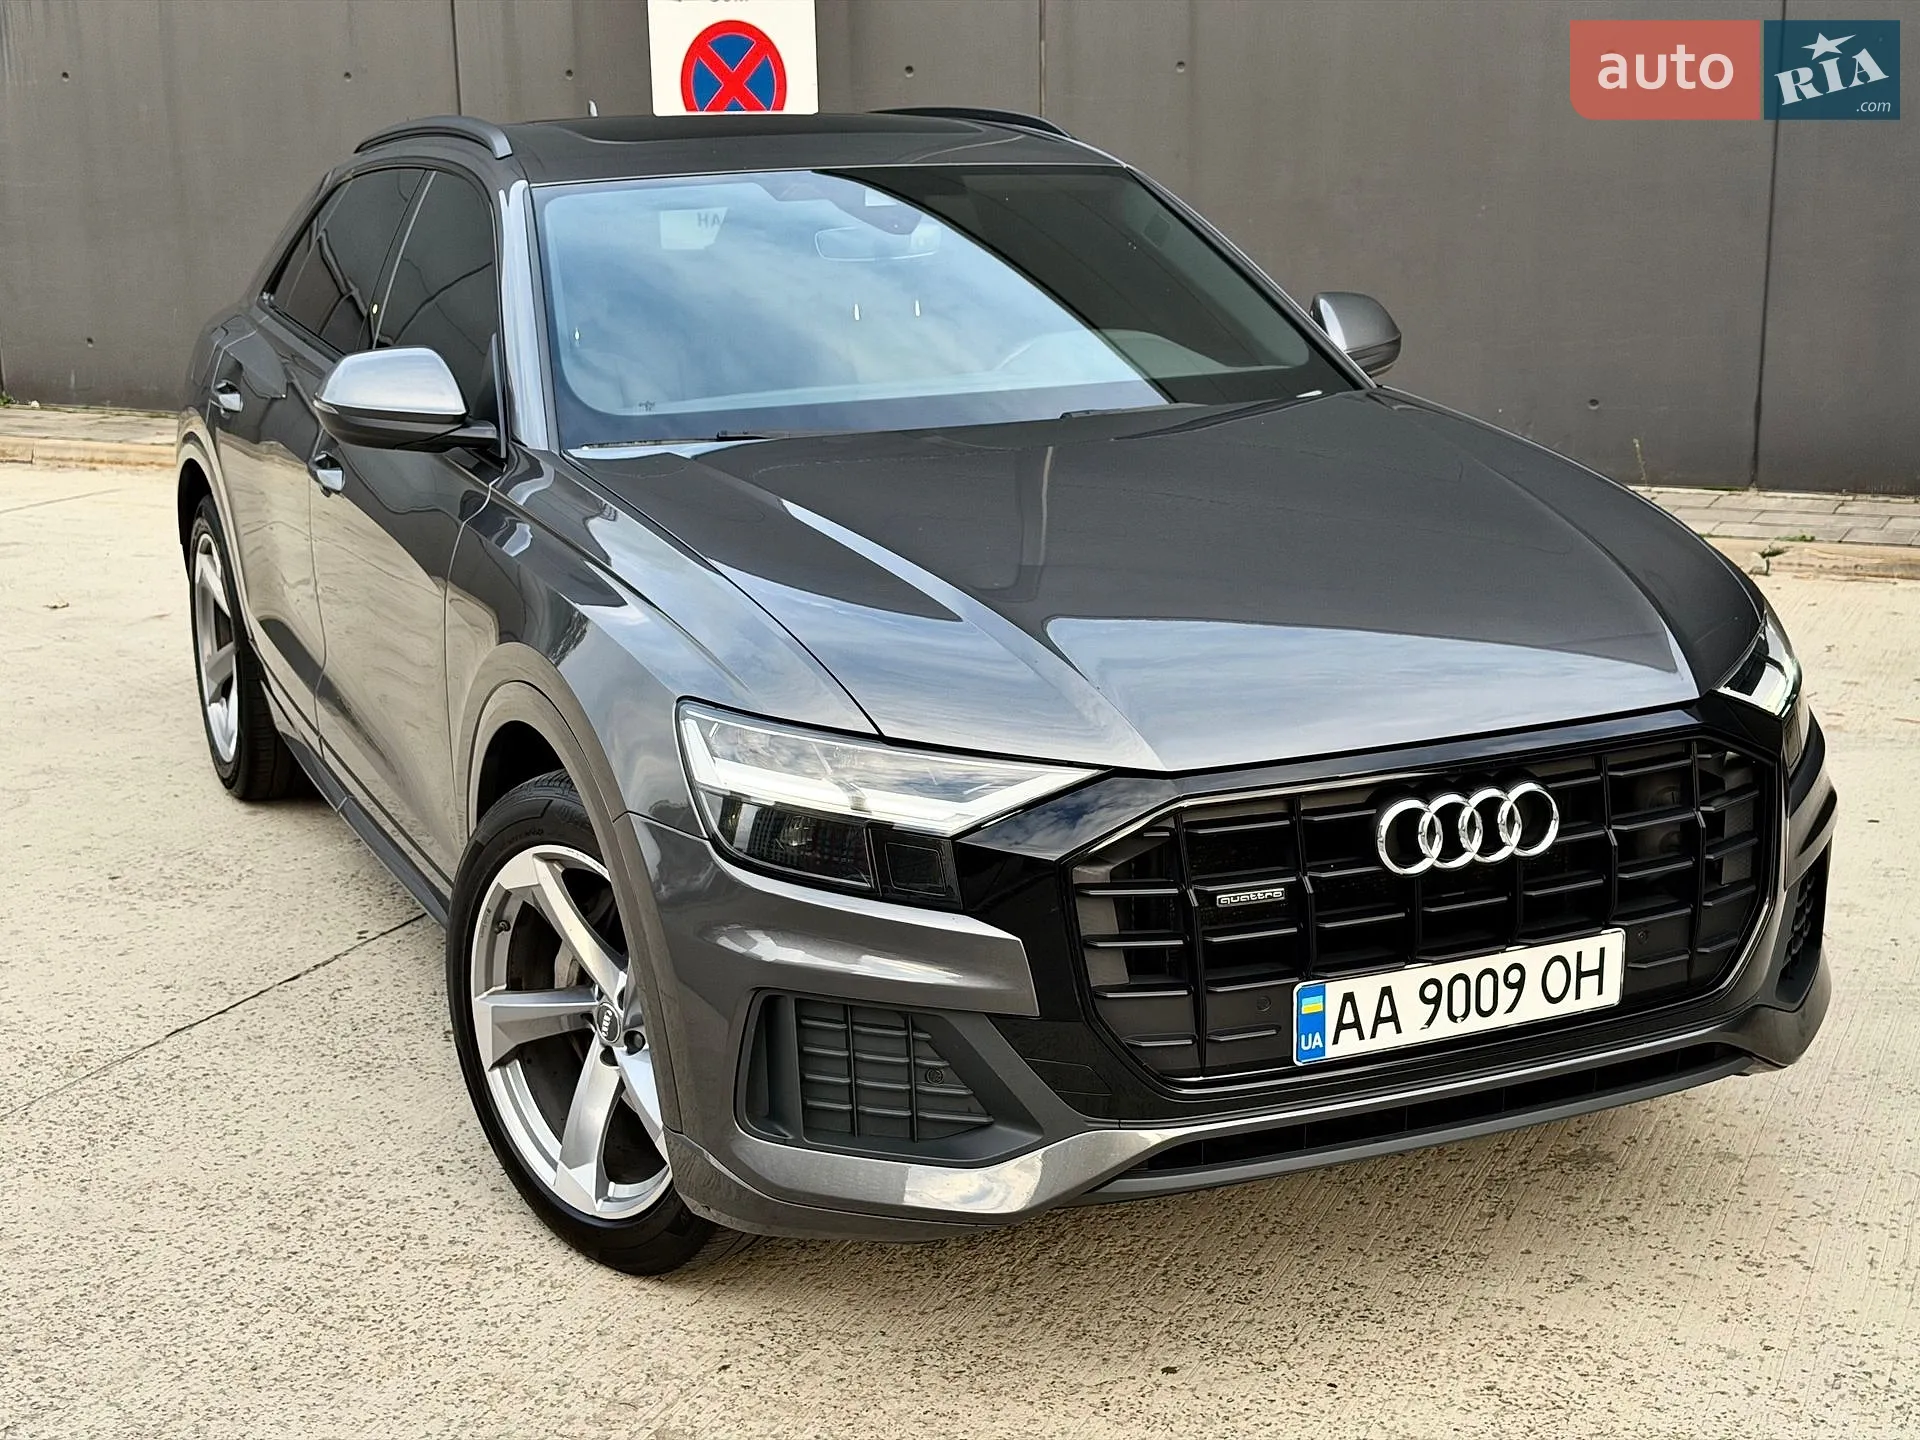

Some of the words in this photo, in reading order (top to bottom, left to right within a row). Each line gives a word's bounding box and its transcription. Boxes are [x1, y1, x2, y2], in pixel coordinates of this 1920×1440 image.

[1220, 891, 1283, 905] quattro
[1331, 985, 1402, 1046] AA
[1418, 962, 1527, 1030] 9009
[1541, 946, 1606, 1004] OH
[1300, 1033, 1323, 1051] UA
